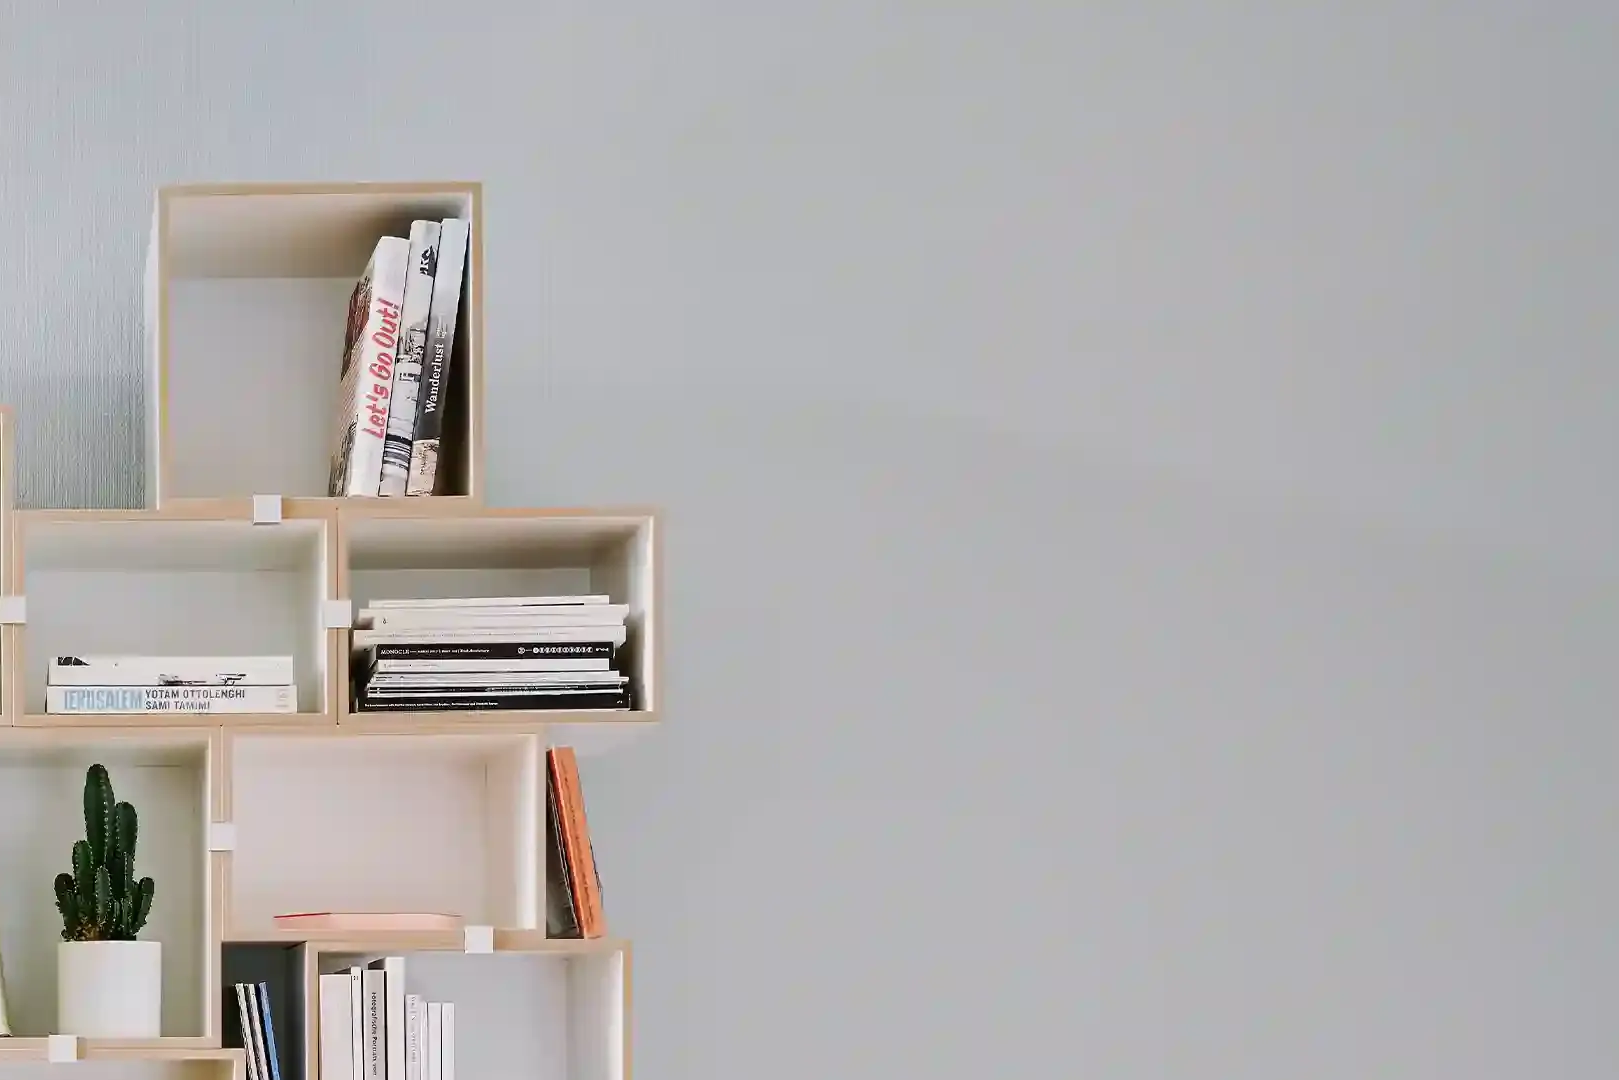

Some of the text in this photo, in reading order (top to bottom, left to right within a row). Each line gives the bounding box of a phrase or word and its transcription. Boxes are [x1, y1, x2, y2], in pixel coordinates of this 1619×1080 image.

[362, 297, 400, 440] Let's Go Out!
[424, 343, 444, 414] Wanderlust
[145, 690, 245, 699] YOTAM OTTOLENGHI
[145, 701, 210, 710] SAMI TAMIMI
